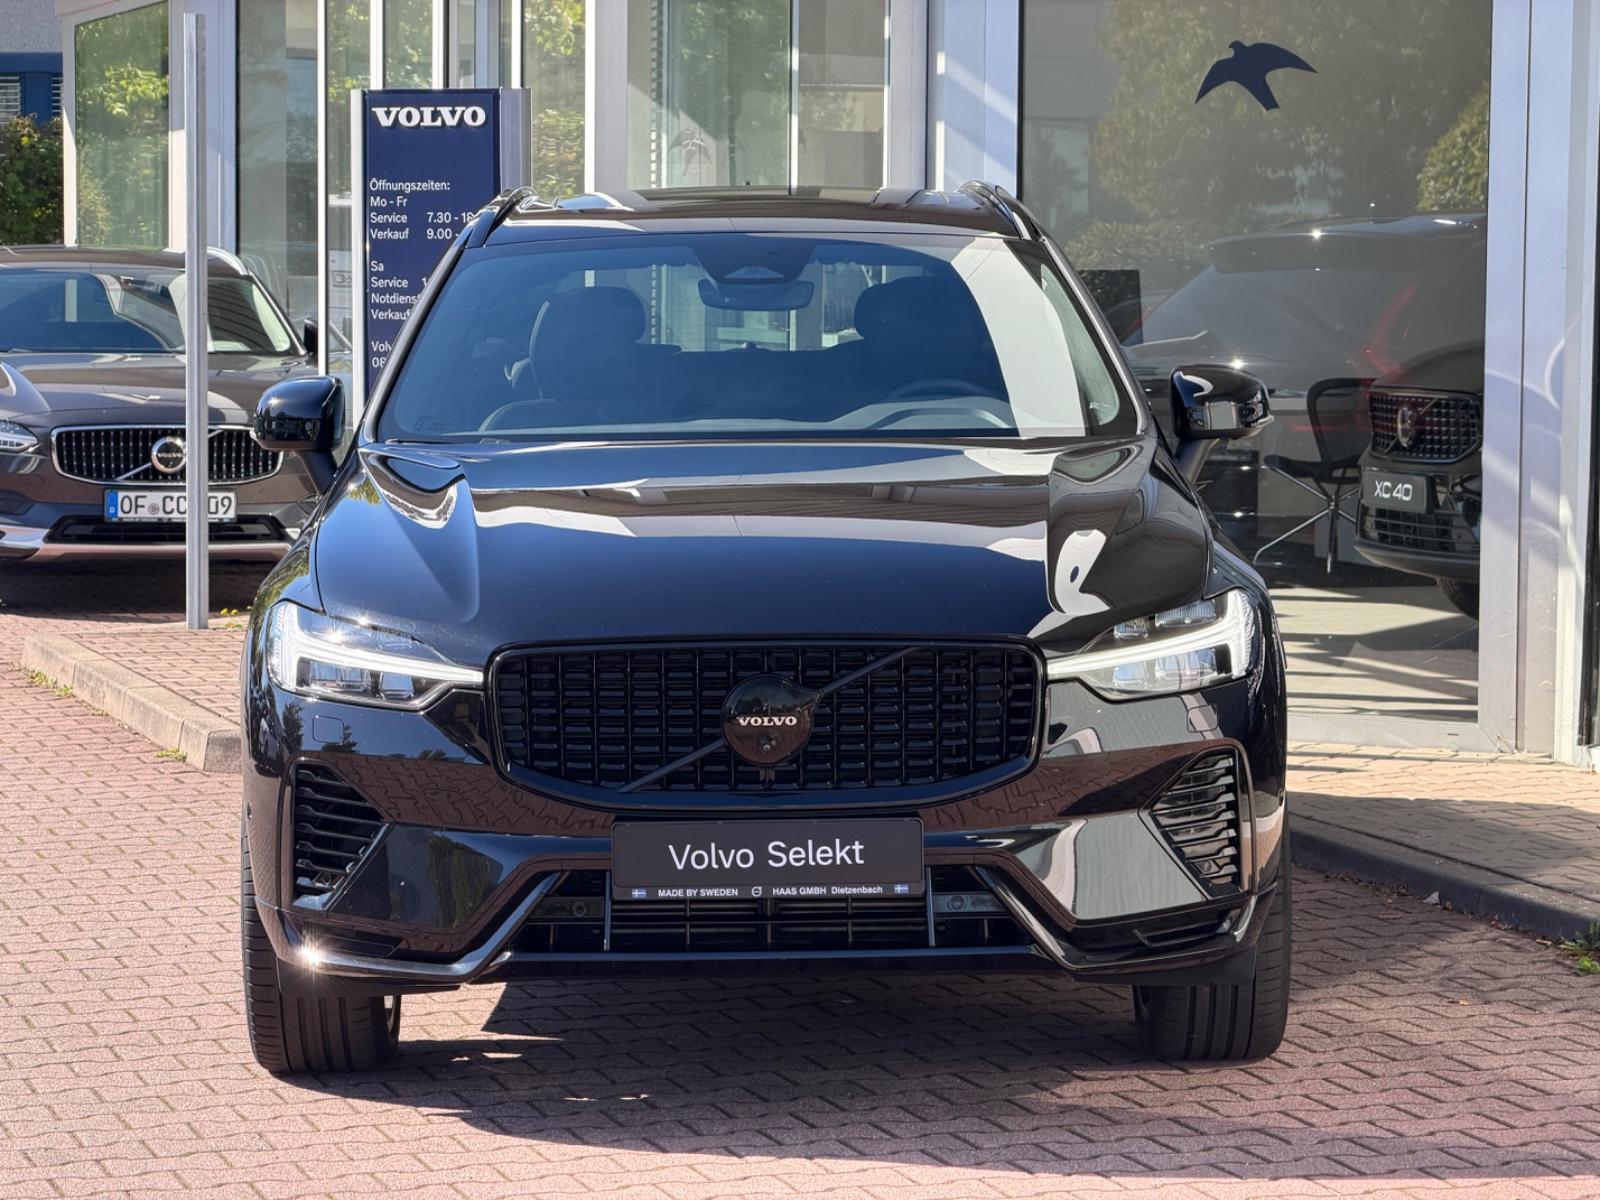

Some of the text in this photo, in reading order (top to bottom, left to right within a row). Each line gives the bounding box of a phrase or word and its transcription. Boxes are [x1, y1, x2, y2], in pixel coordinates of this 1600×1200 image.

[372, 106, 486, 127] VOLVO
[369, 178, 450, 193] Öffnungszeiten:
[370, 196, 388, 207] Mo
[396, 196, 407, 207] Fr
[370, 213, 408, 223] Service
[426, 212, 452, 223] 7.30
[370, 229, 410, 239] Verkauf
[426, 228, 453, 239] 9.00
[370, 261, 384, 271] Sa
[371, 277, 409, 287] Service
[120, 495, 147, 515] OF
[736, 716, 798, 727] VOLVO
[668, 838, 865, 870] Volvo Selekt
[658, 884, 884, 897] MADE BY SWEDEN HAAS GMBH Dietzenbach
